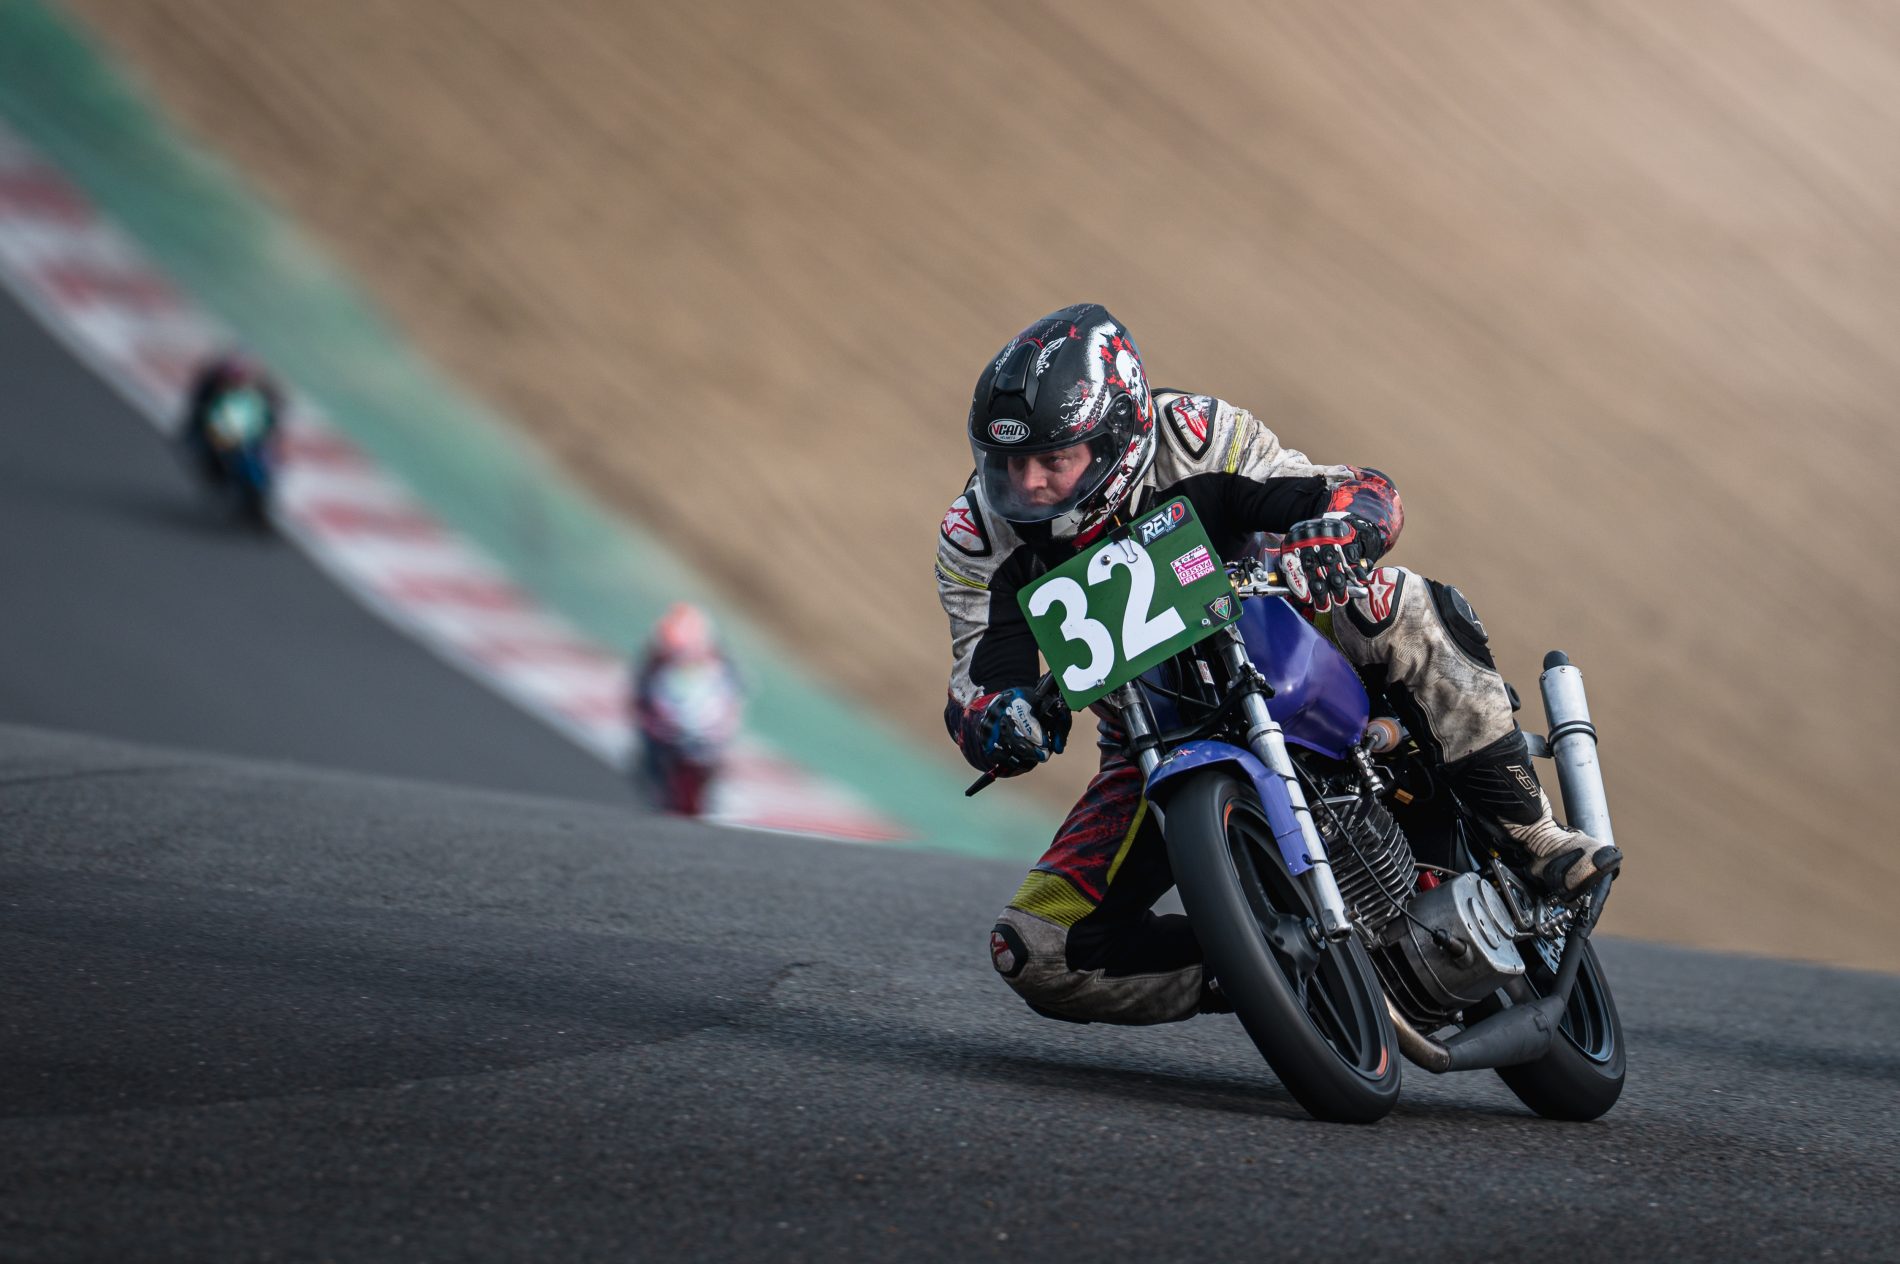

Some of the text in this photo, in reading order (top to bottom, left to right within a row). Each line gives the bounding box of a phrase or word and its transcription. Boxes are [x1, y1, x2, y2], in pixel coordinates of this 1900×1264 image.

[1181, 560, 1211, 579] PASSED
[1181, 573, 1198, 586] TEST
[1028, 539, 1187, 692] 32
[1506, 765, 1541, 798] RST
